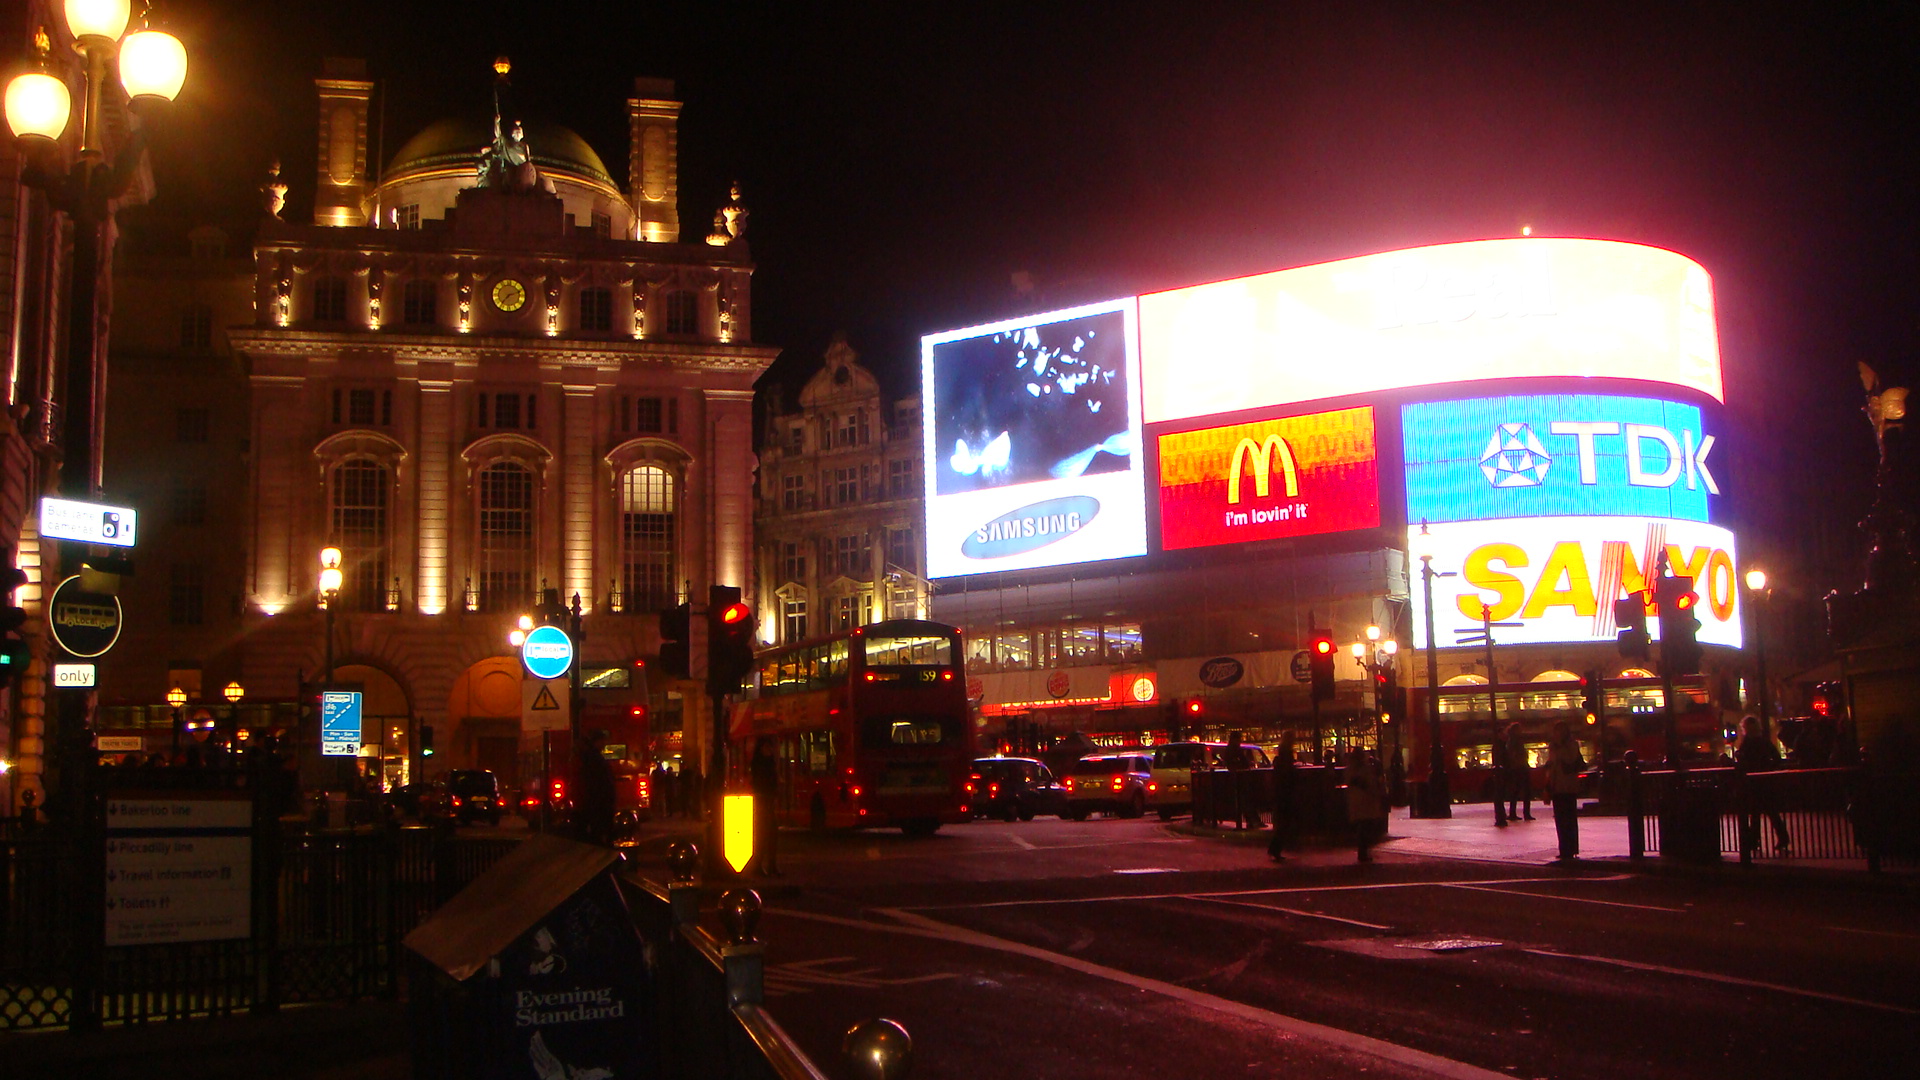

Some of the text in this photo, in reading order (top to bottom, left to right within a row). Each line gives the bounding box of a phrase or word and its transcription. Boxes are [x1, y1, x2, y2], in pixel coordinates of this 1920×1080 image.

[1550, 421, 1720, 495] TDK
[47, 505, 95, 520] Bus lane
[1225, 503, 1308, 527] i'm lovin' it
[47, 521, 95, 535] cameras
[976, 511, 1081, 544] SAMSUNG
[60, 669, 90, 684] only
[1206, 661, 1238, 682] Boots
[120, 804, 191, 815] Bakerloo line
[119, 842, 194, 855] Piccadilly line
[120, 869, 219, 881] Travel information
[515, 986, 612, 1009] Evening
[515, 1000, 625, 1027] Standard
